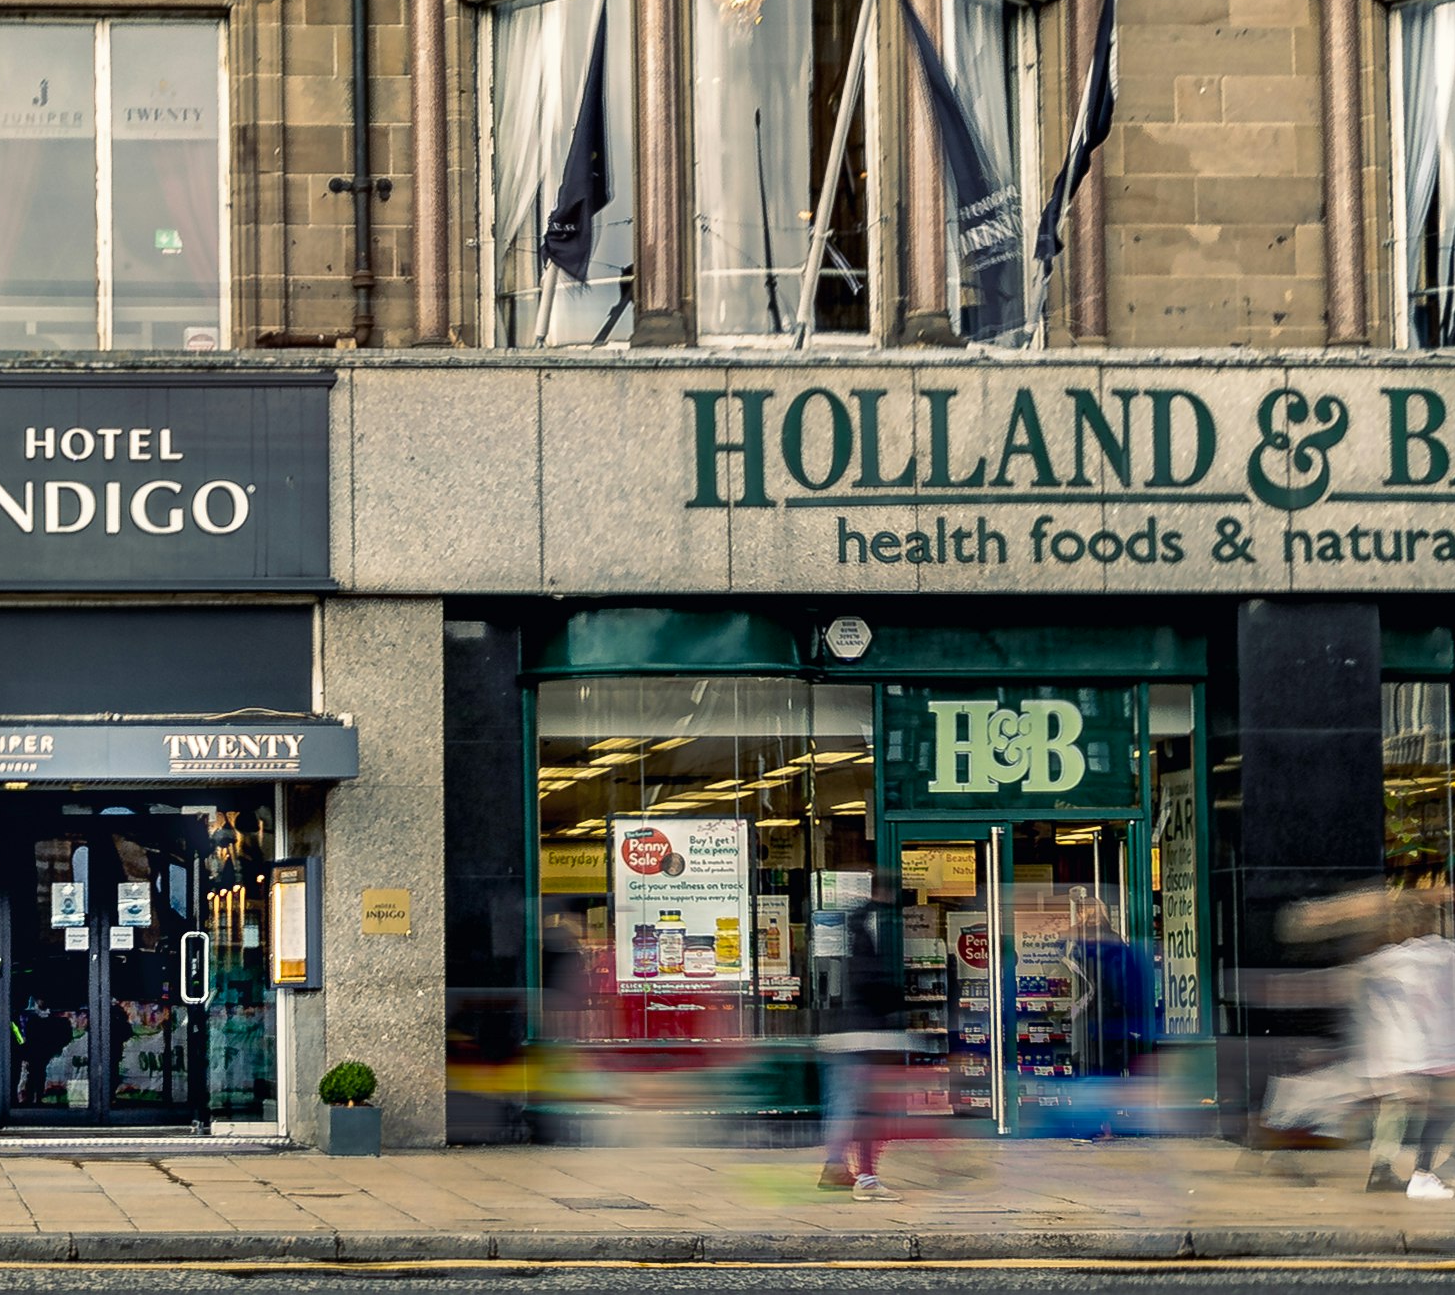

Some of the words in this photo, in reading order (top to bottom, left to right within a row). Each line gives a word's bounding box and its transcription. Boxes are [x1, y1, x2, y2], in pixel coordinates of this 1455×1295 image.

[2, 112, 83, 125] JUNIPER
[125, 107, 205, 122] TWENTY
[24, 427, 184, 460] HOTEL
[683, 386, 1218, 508] HOLLAND
[1247, 387, 1350, 510] &
[836, 516, 1006, 564] health
[1029, 515, 1185, 564] foods
[1212, 517, 1256, 563] &
[163, 734, 306, 759] TWENTY
[928, 699, 1086, 793] H&B
[629, 839, 669, 856] Penny
[689, 835, 707, 846] Buy
[715, 835, 729, 846] get
[548, 851, 600, 868] Everyday
[628, 853, 658, 866] Sale
[712, 848, 739, 857] penny
[629, 880, 646, 891] Get
[648, 883, 667, 892] your
[669, 881, 705, 890] wellness
[366, 910, 406, 919] INDIGO
